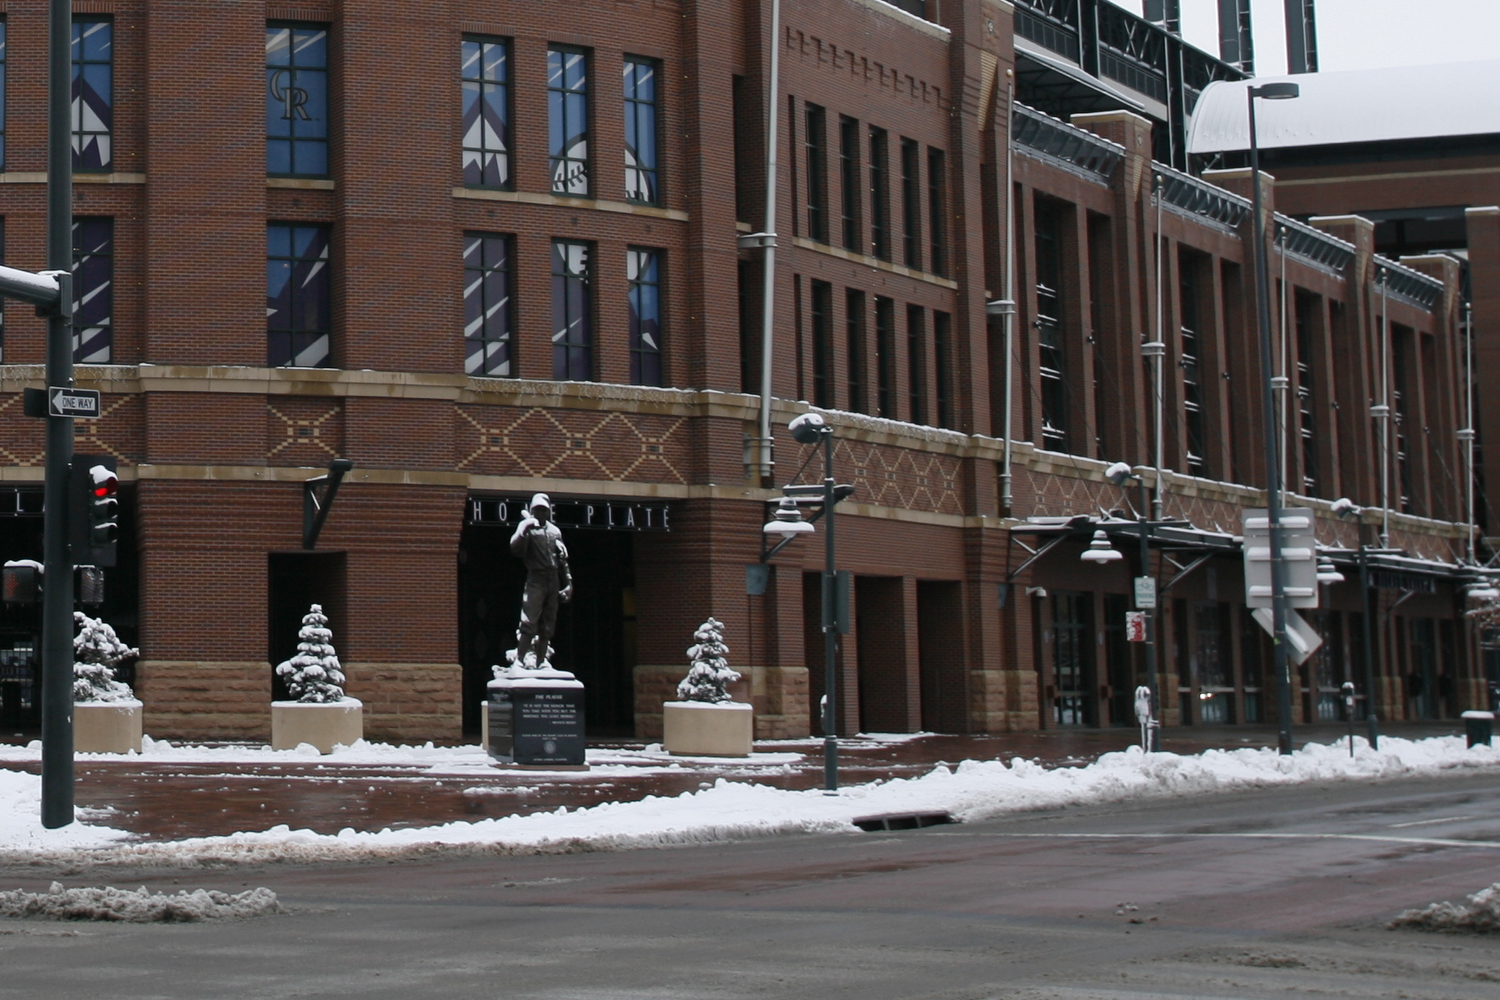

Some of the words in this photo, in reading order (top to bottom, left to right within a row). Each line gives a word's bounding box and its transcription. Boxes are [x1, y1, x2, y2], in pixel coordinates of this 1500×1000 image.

[62, 397, 76, 408] ONE
[77, 398, 94, 409] WAY
[473, 501, 556, 523] HOE
[587, 505, 669, 528] PLATE
